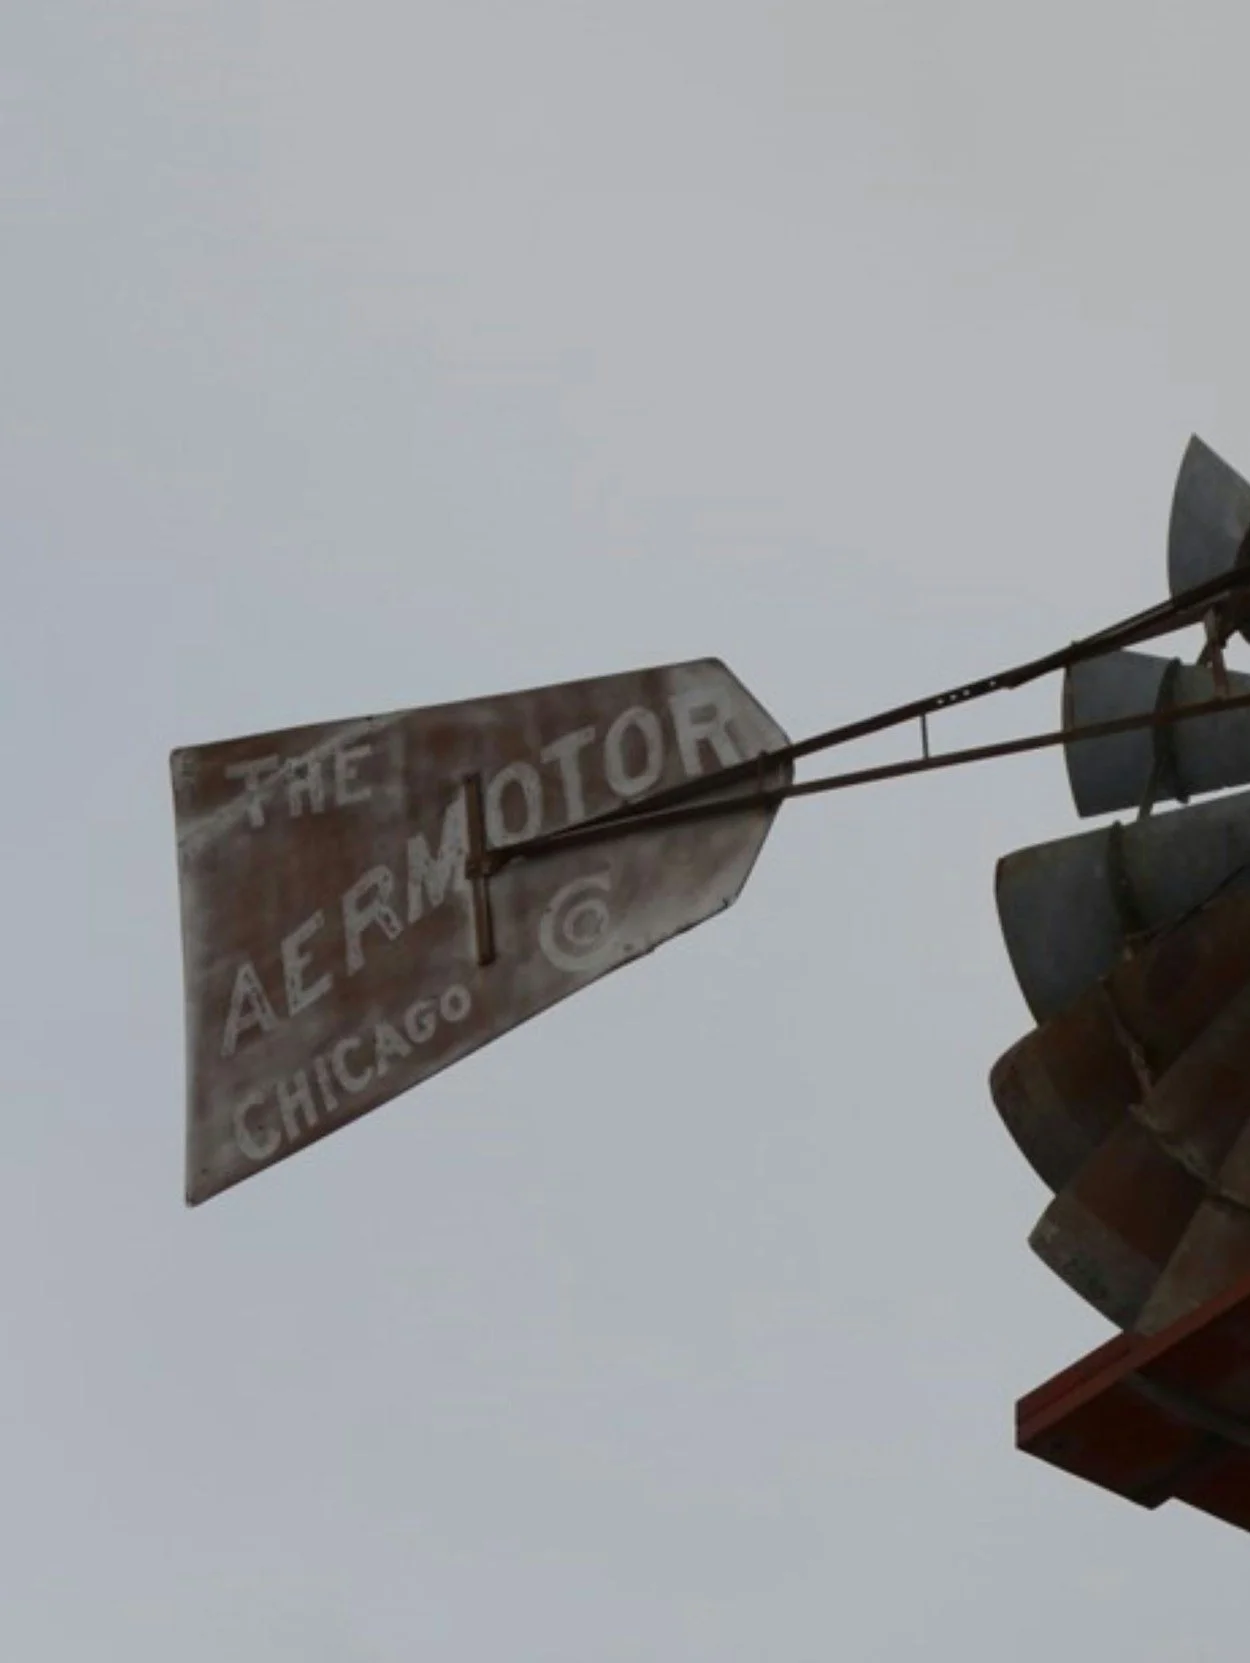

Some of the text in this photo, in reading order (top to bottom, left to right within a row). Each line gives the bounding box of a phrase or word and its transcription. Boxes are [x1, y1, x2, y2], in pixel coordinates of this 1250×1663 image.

[224, 743, 373, 829] THE
[220, 694, 748, 1057] AERMOTOR
[232, 984, 472, 1161] CHICAGO
